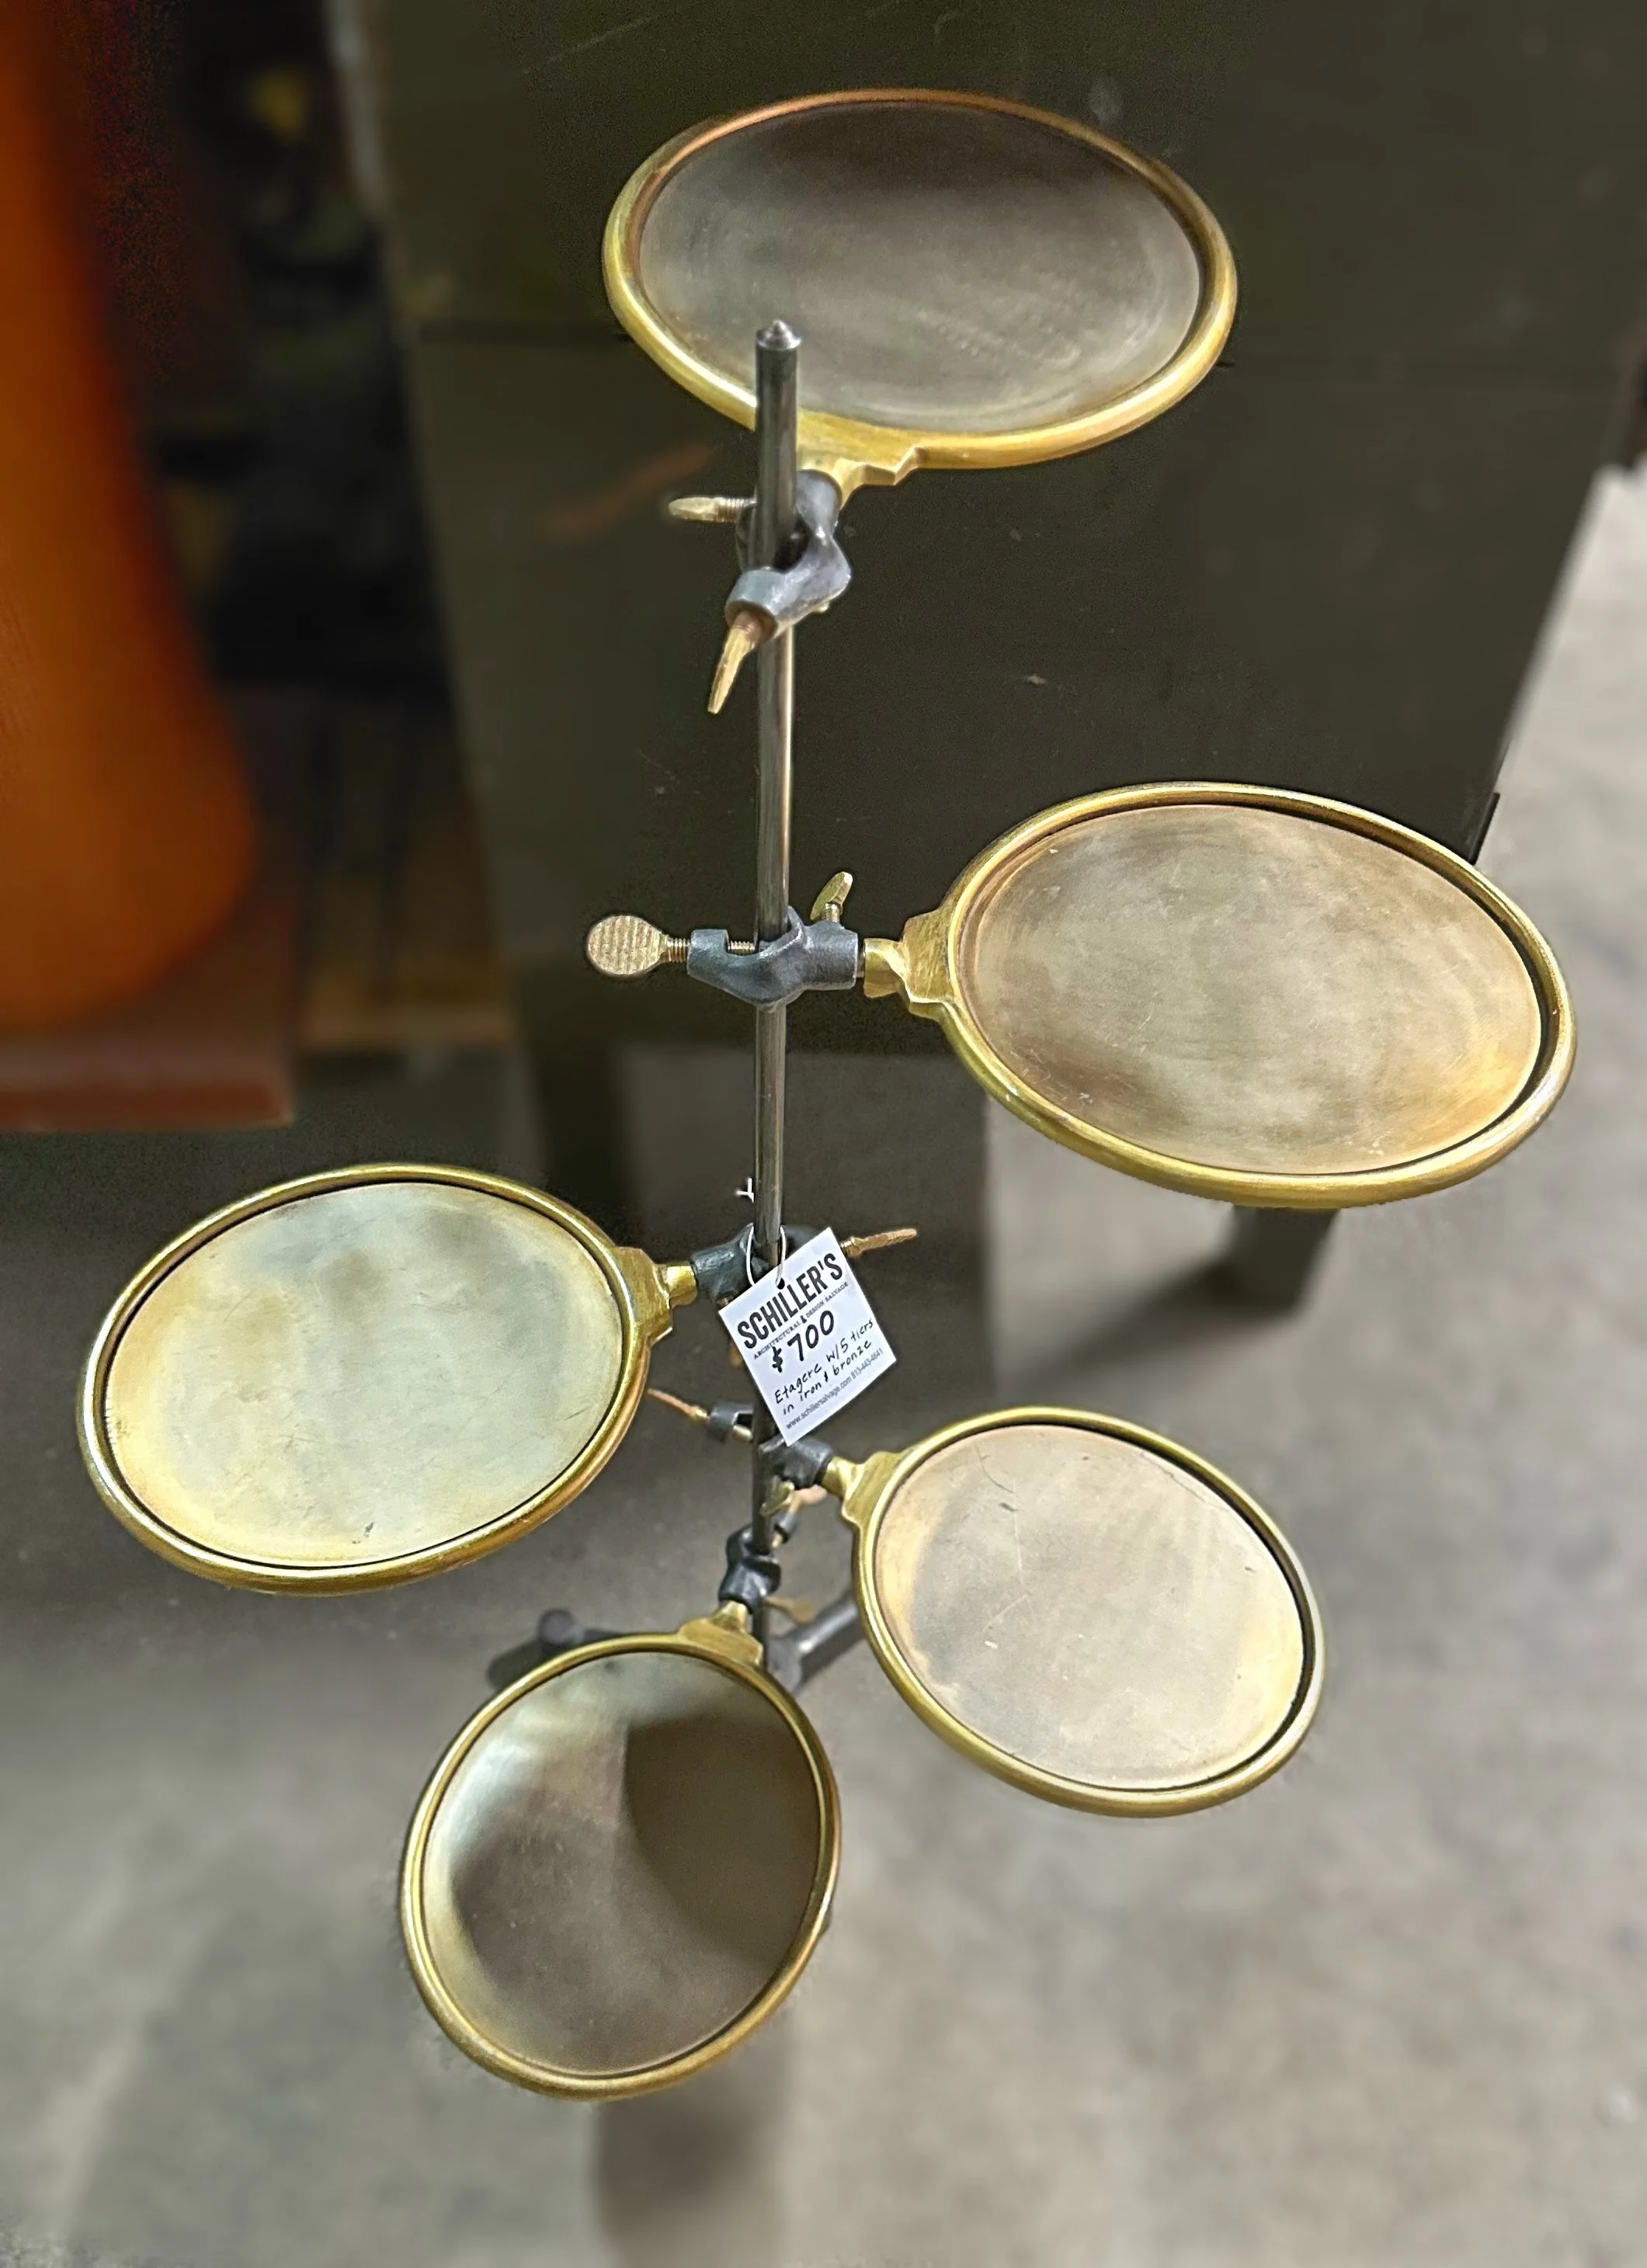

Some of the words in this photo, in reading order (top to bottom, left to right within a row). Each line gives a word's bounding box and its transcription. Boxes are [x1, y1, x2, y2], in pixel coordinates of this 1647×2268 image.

[737, 1252, 843, 1349] SCHILLER'S
[753, 1320, 801, 1360] ARCHITECTURAL
[800, 1315, 808, 1324] &
[805, 1299, 825, 1318] DESIGN
[825, 1281, 849, 1303] SALVAGE
[783, 1404, 794, 1415] in
[799, 1382, 822, 1402] iron
[832, 1339, 872, 1376] bronze
